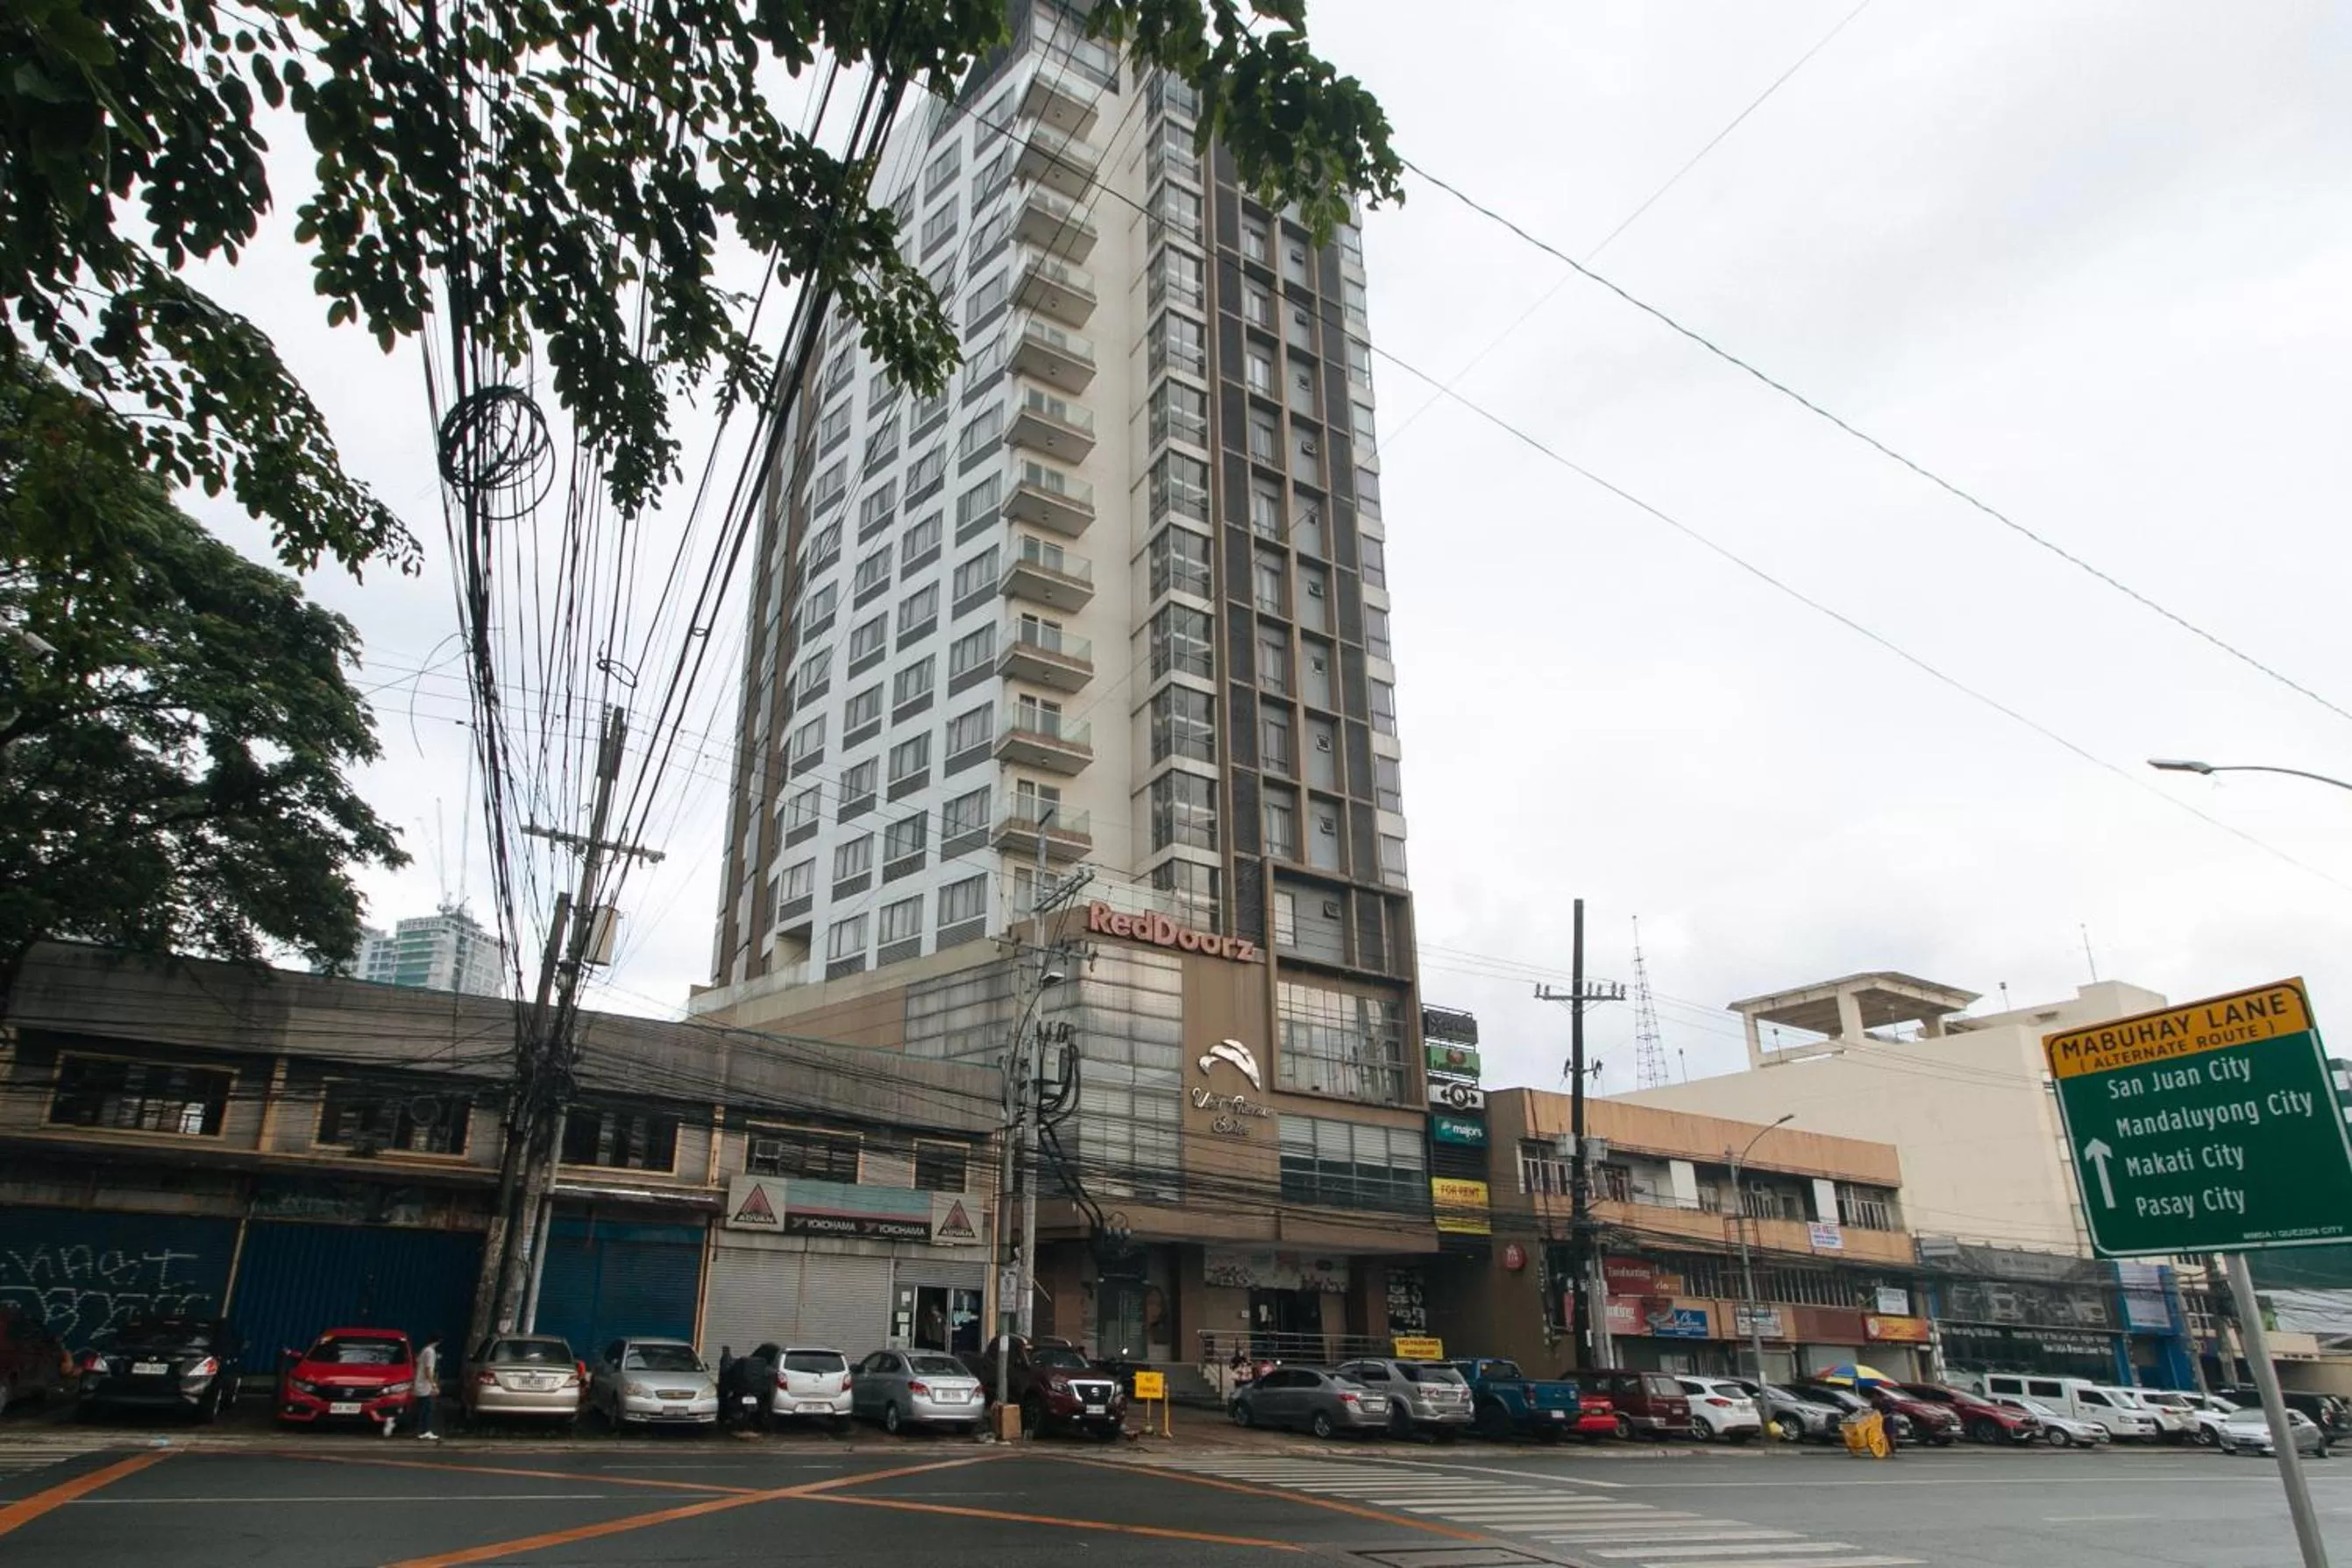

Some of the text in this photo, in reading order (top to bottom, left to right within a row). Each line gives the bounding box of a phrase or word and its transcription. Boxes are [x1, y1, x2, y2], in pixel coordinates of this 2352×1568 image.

[1089, 901, 1255, 961] RedDoorz
[2060, 992, 2289, 1061] MABUHAY LANE
[2107, 1055, 2252, 1100] San Juan City
[2115, 1089, 2314, 1139] Mandaluyong City
[2125, 1143, 2246, 1177] Makati City
[2135, 1186, 2246, 1219] Pasay City
[807, 1218, 856, 1231] YOKOHAMA
[878, 1223, 926, 1236] YOKOHAMA
[2278, 1227, 2320, 1238] QUEZON
[2320, 1225, 2344, 1235] CITY
